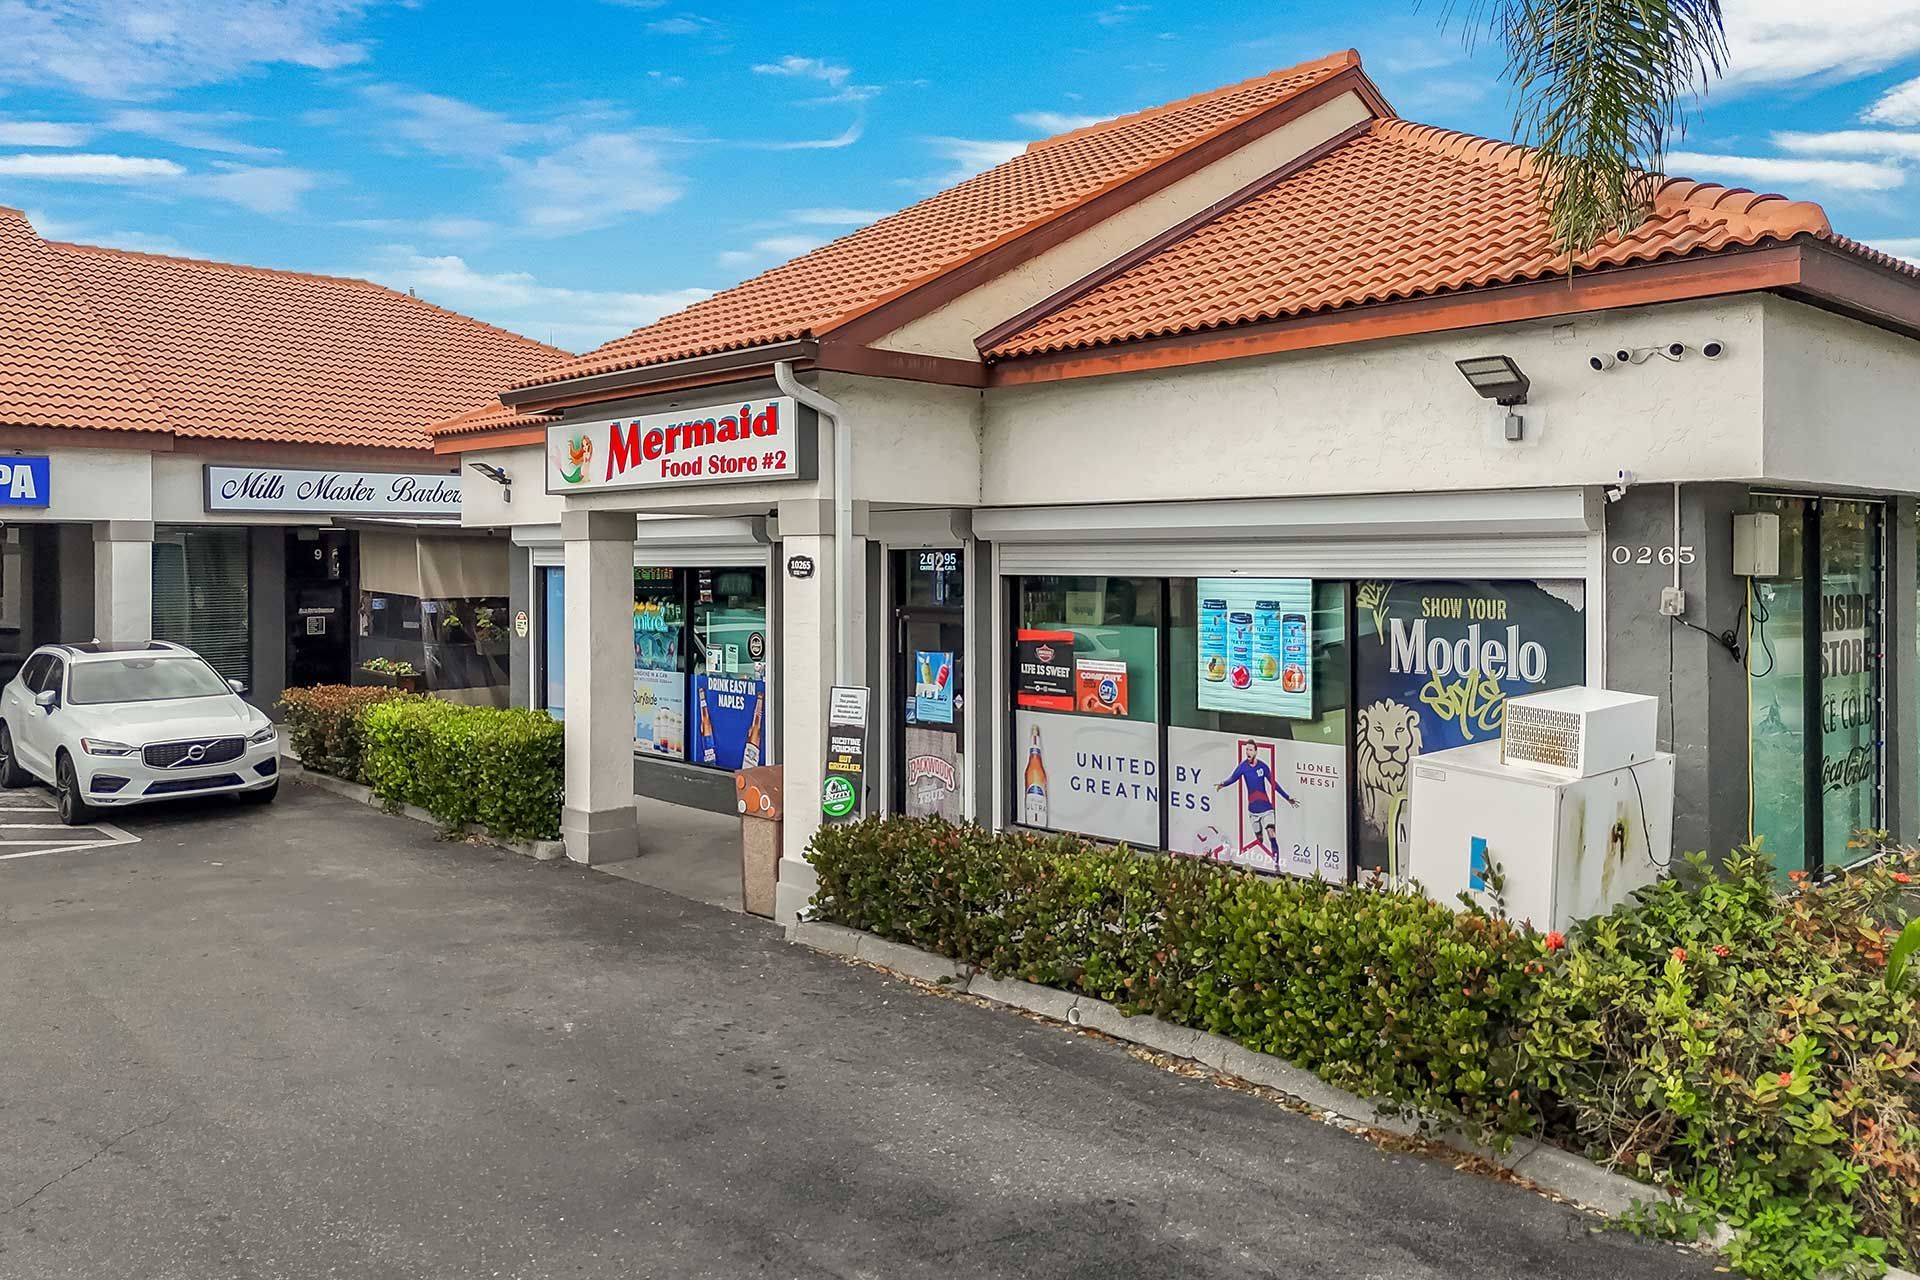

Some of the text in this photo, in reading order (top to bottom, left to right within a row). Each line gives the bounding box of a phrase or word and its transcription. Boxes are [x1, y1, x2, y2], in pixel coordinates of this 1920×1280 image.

[605, 402, 779, 482] Mermaid
[661, 450, 787, 478] Food Store #2
[221, 471, 286, 500] Mills
[296, 473, 376, 502] Master
[314, 549, 322, 560] 9
[1612, 546, 1696, 565] 0265
[791, 560, 811, 570] 10265
[1422, 596, 1507, 620] SHOW YOUR
[1823, 593, 1873, 632] NSIDE
[1389, 617, 1548, 684] Modelo
[1822, 637, 1872, 679] STORE
[1021, 663, 1036, 674] LIFE
[1036, 664, 1045, 675] IS
[1045, 666, 1070, 678] SWEET
[708, 677, 756, 695] DRINK EASY IN
[718, 694, 745, 710] NAPLES
[1841, 688, 1872, 730] COLD
[1077, 752, 1202, 784] UNITED BY
[1256, 768, 1264, 777] 10
[1296, 762, 1338, 774] LIONEL
[1300, 777, 1335, 788] MESSI
[1293, 844, 1340, 863] 2.6 95
